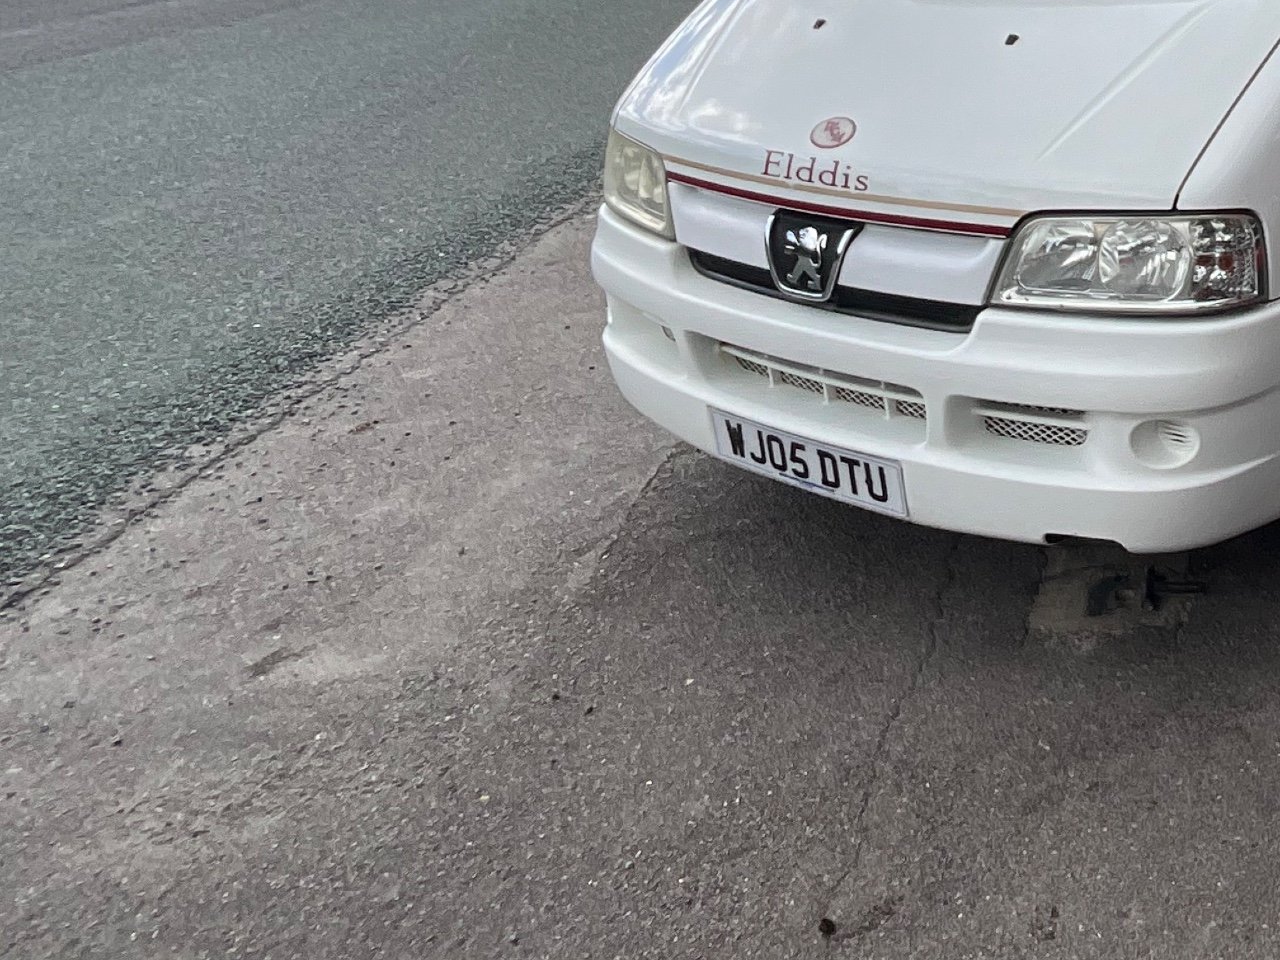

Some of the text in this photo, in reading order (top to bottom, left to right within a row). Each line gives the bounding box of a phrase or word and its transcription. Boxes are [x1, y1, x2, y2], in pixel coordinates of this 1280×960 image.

[761, 149, 869, 191] Elddis
[725, 419, 889, 503] WJ05 DTU
